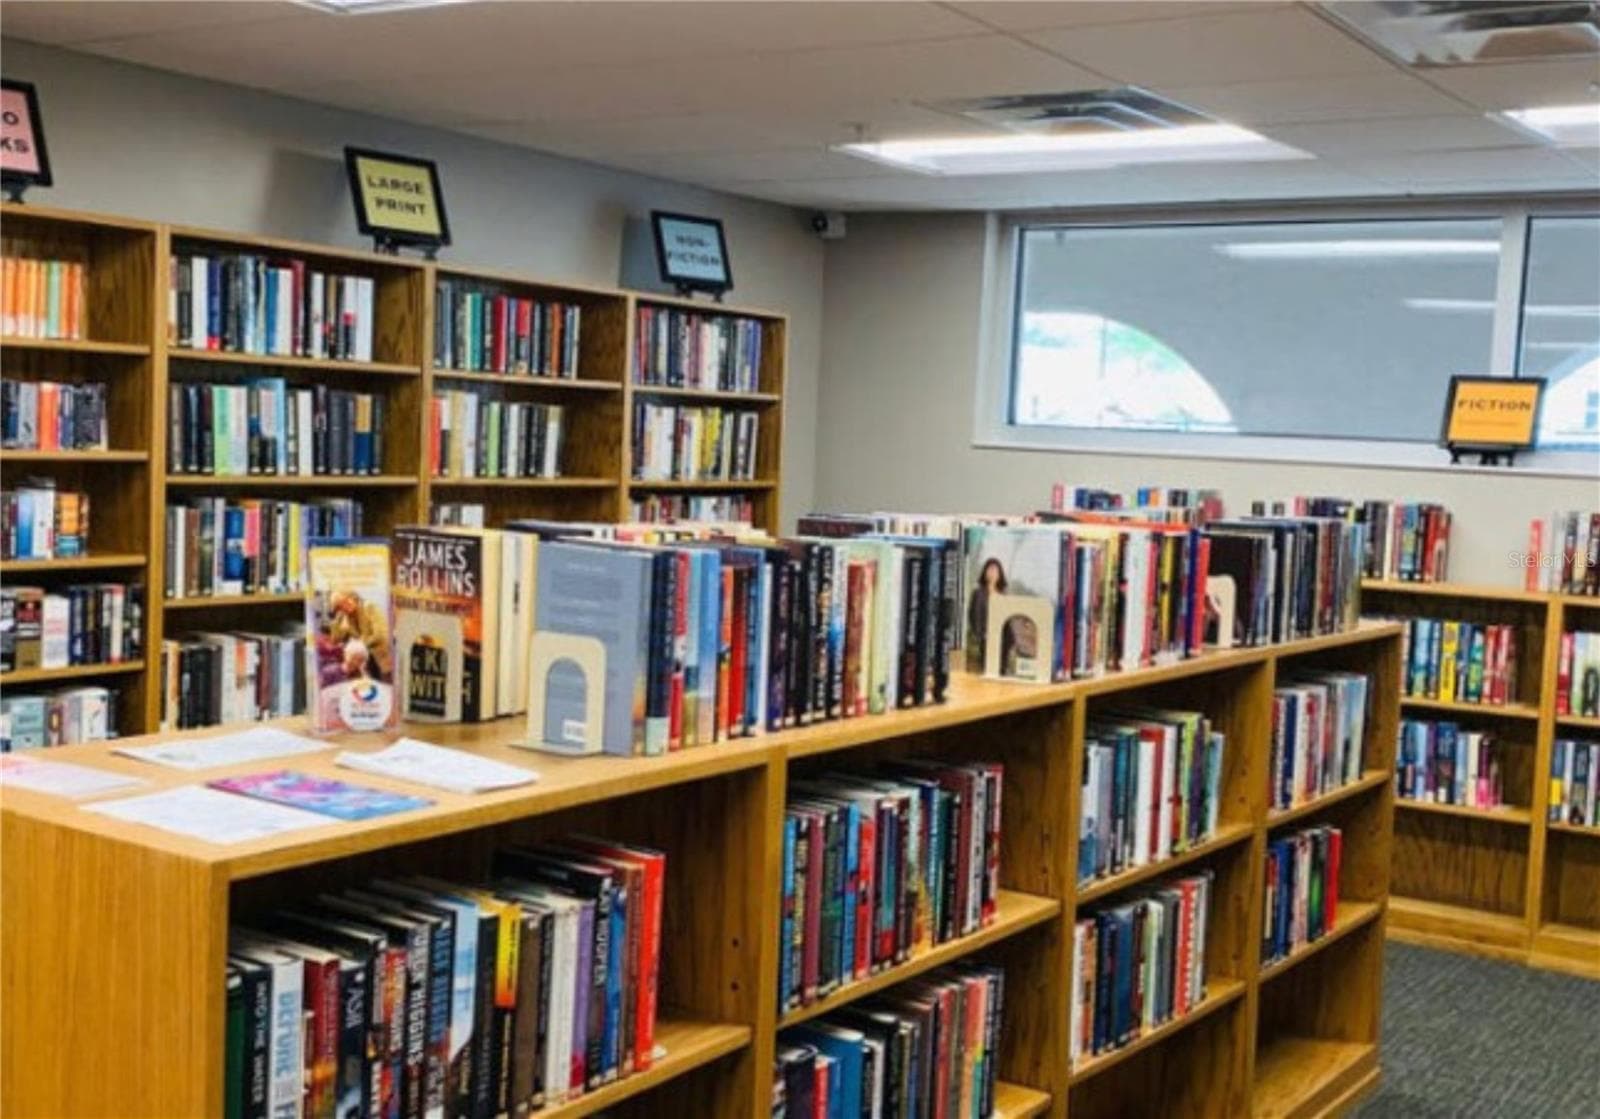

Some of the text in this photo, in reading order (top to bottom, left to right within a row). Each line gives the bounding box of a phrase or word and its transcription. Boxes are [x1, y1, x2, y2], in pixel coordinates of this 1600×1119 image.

[366, 175, 424, 195] LARGE
[375, 196, 426, 216] PRINT
[675, 233, 711, 248] NON-
[667, 250, 721, 267] FICTION
[1458, 398, 1532, 411] FICTION
[402, 540, 467, 570] JAMES
[396, 564, 476, 598] ROLLINS
[407, 987, 427, 1066] HIGGINS
